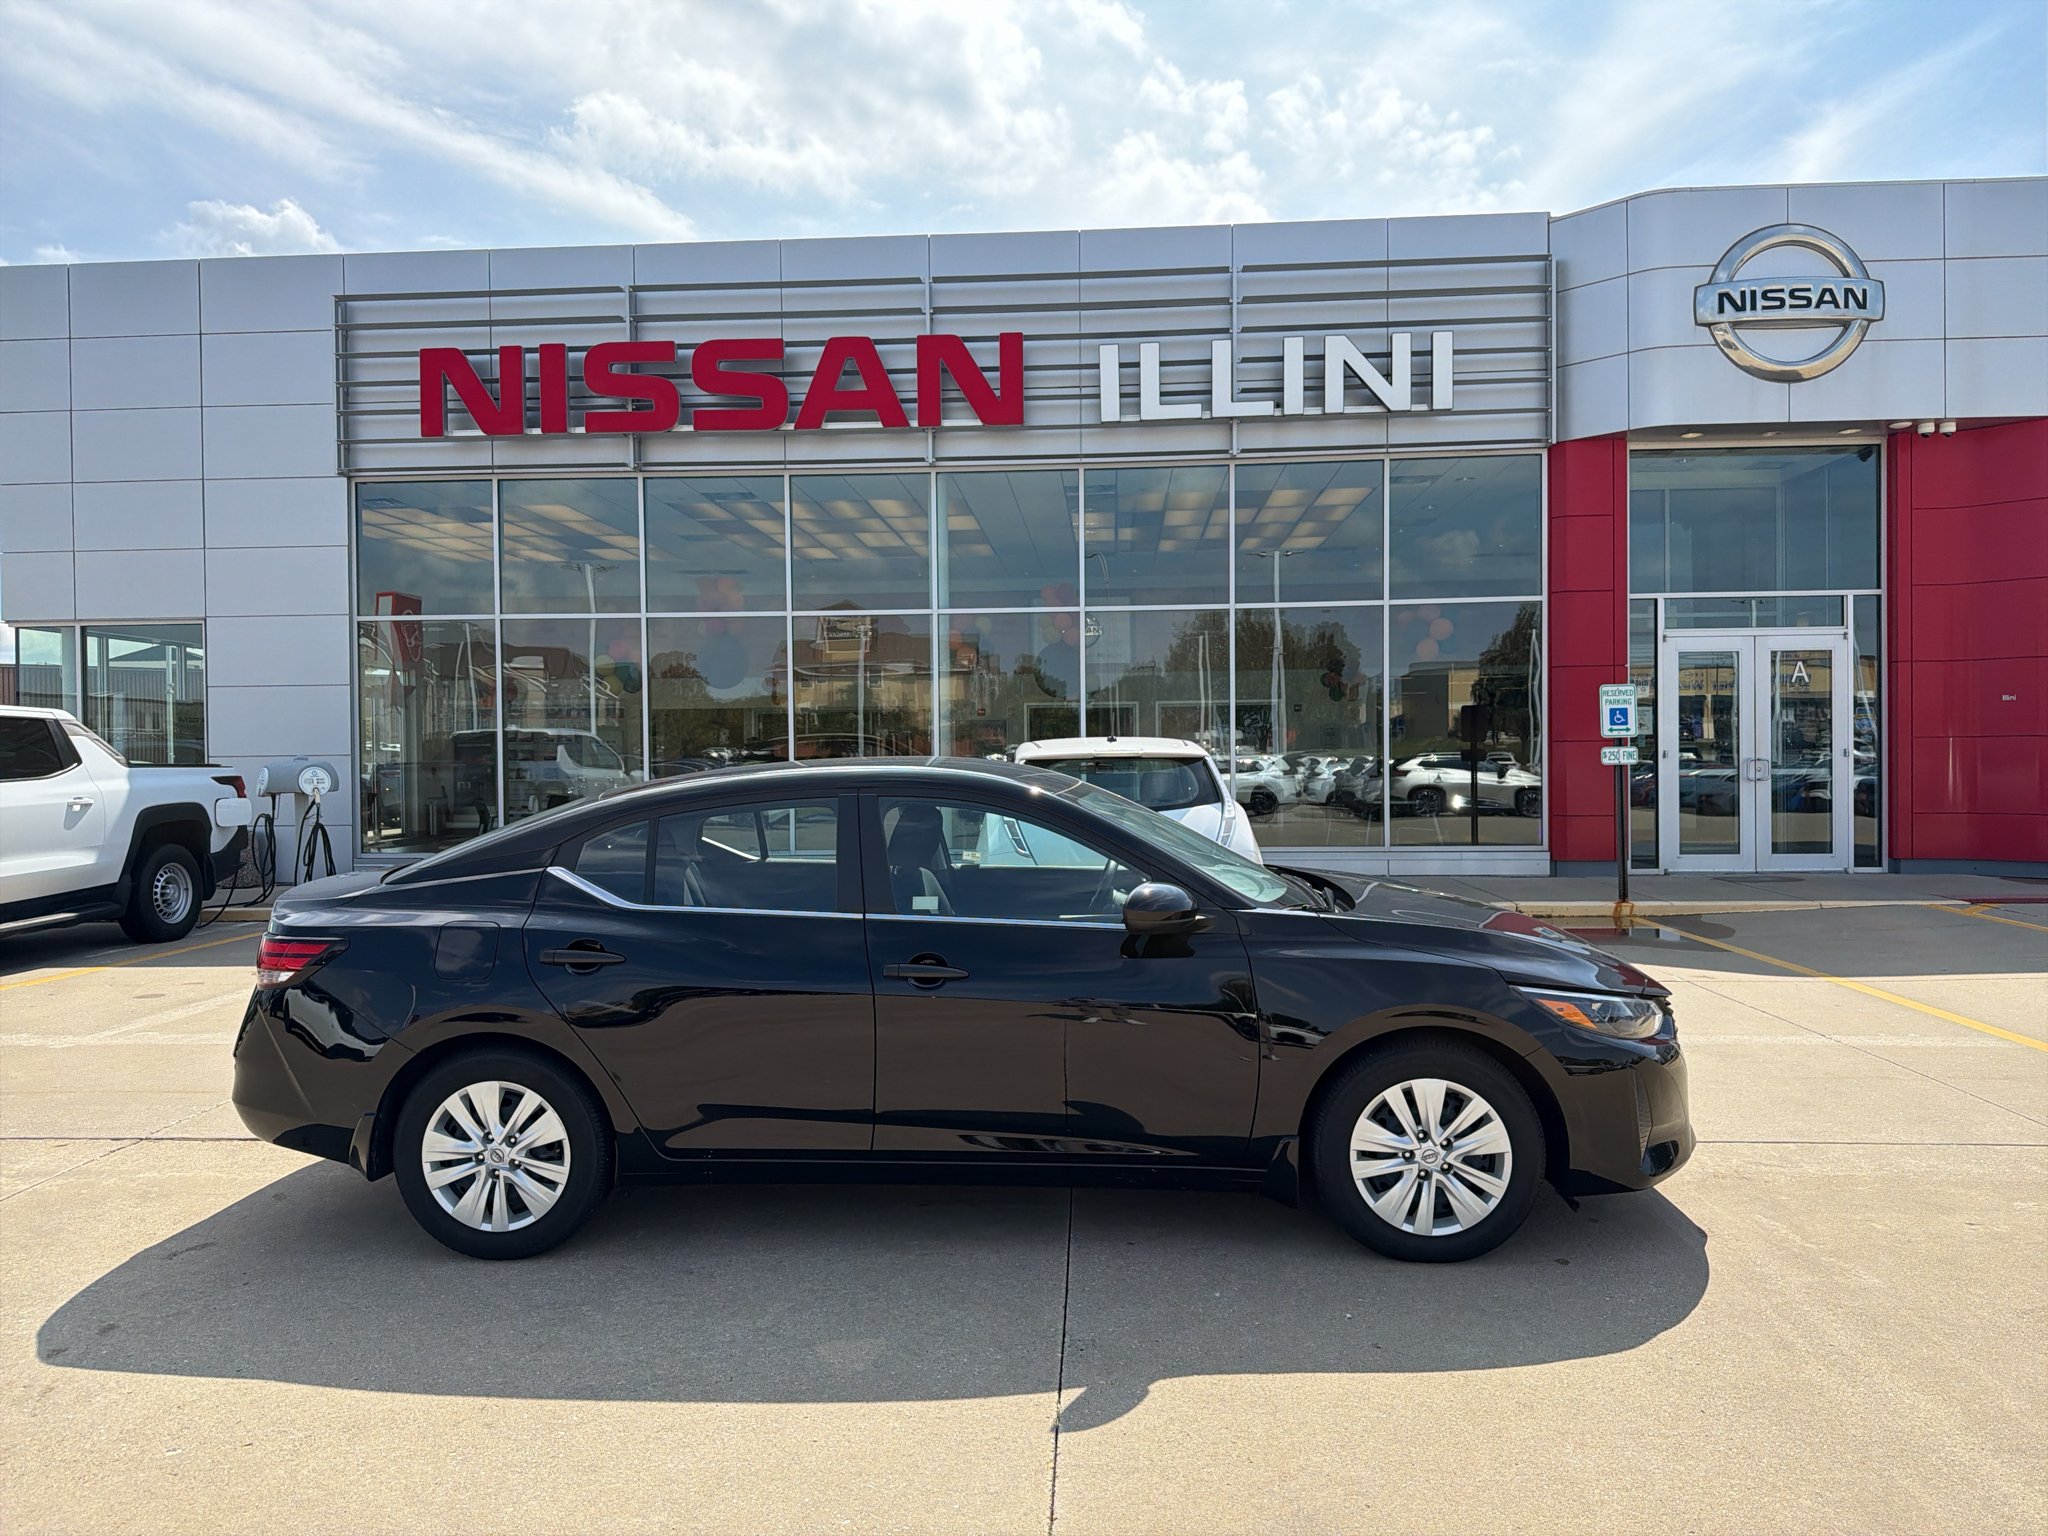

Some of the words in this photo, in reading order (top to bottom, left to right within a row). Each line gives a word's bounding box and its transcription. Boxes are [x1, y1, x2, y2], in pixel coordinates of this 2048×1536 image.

[1717, 287, 1868, 314] NISSAN
[420, 332, 1025, 437] NISSAN
[1099, 331, 1454, 422] ILLINI
[1791, 660, 1810, 683] A
[1602, 689, 1634, 697] RESERVED
[1604, 698, 1633, 706] PARKING
[1602, 751, 1620, 761] $250
[1622, 750, 1637, 761] FINE
